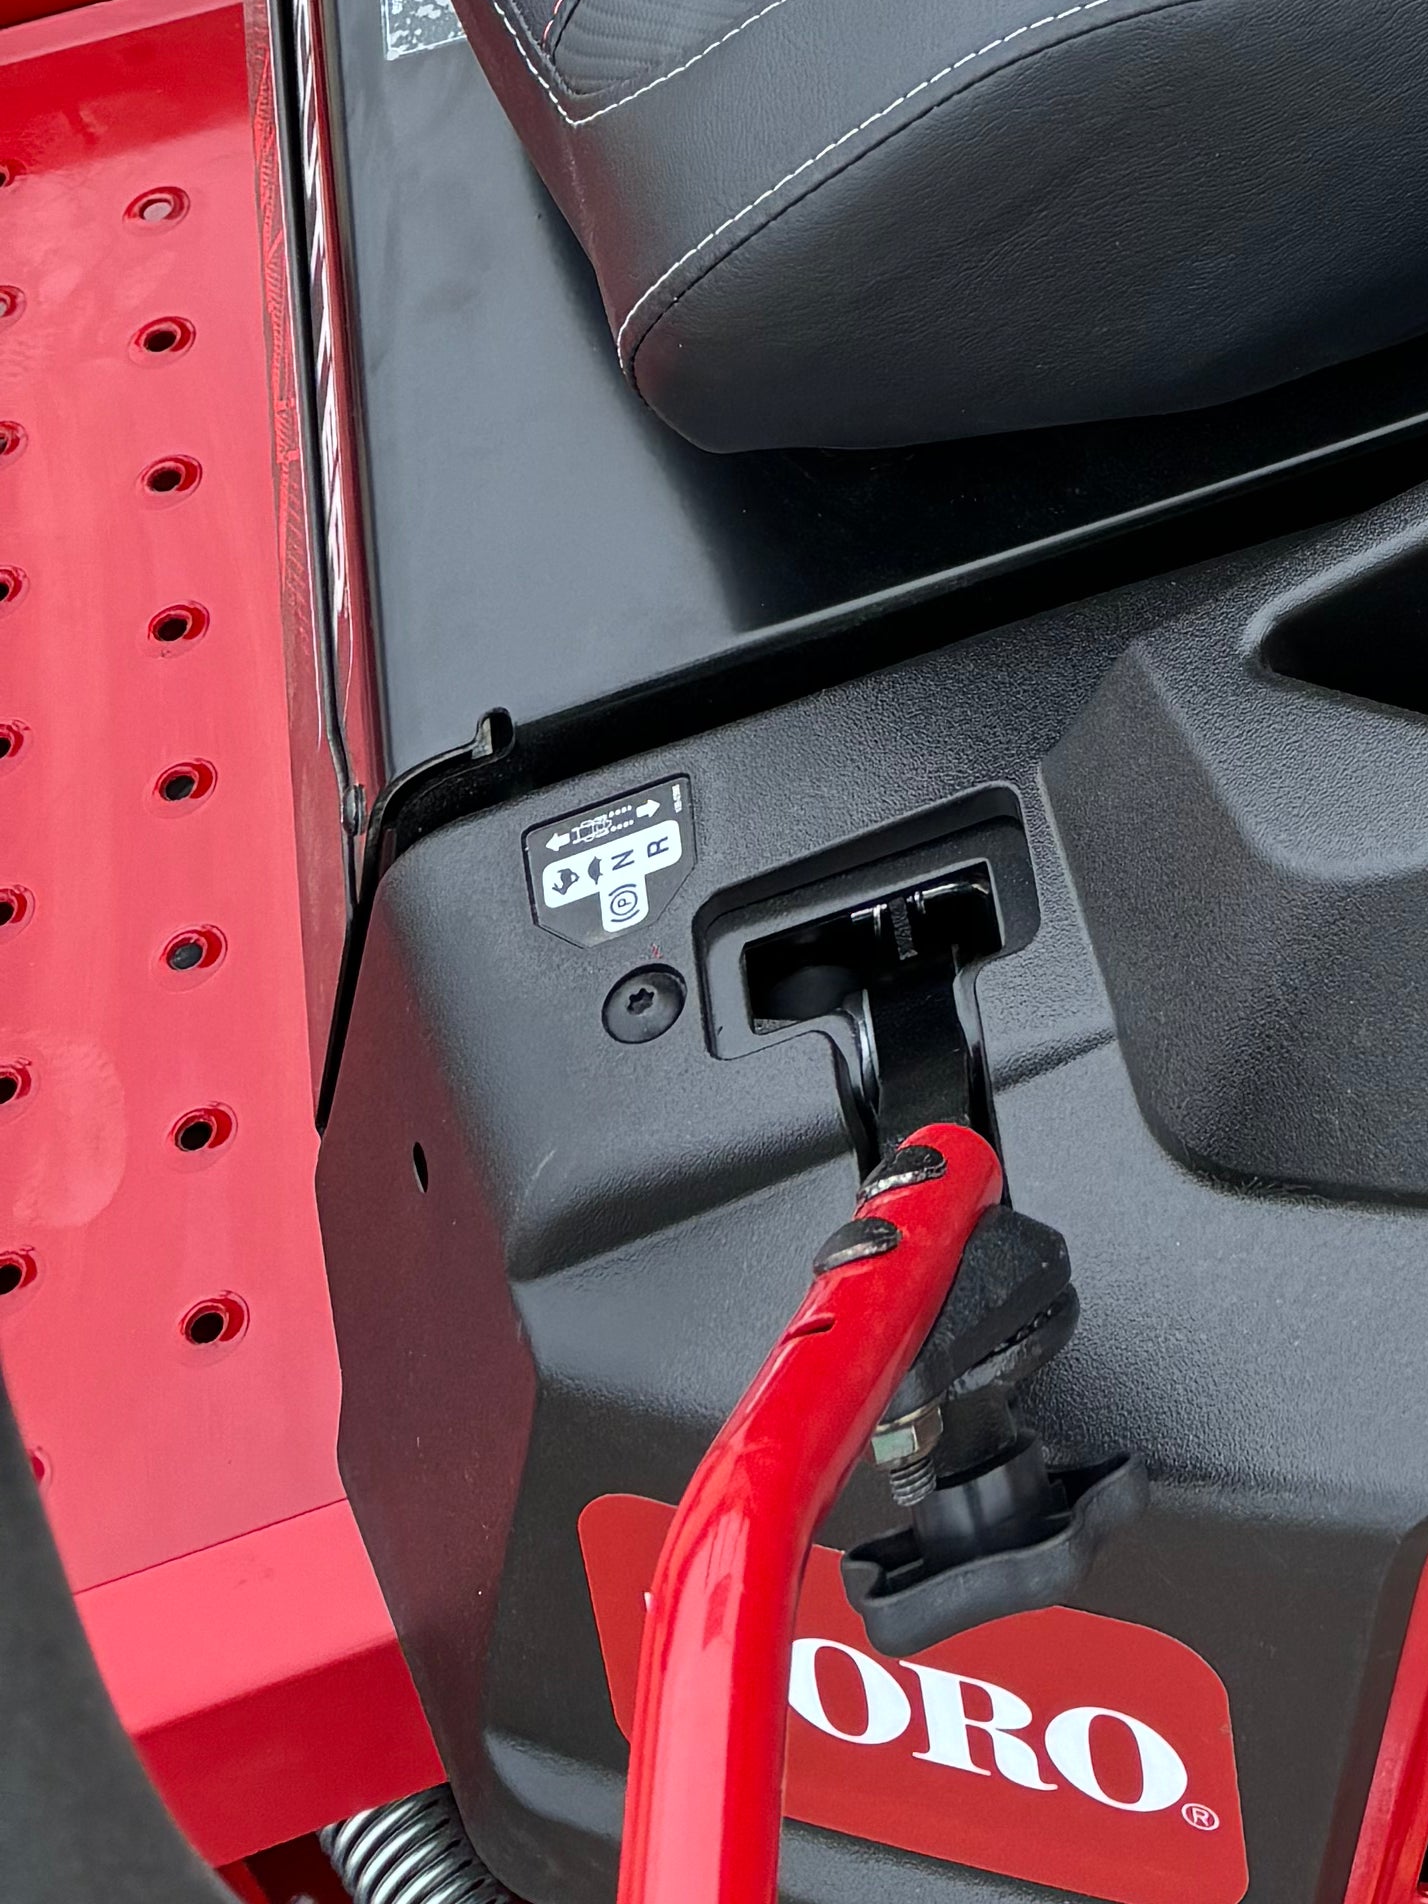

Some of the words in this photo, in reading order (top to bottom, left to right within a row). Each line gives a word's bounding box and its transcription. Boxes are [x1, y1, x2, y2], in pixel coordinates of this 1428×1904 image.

[647, 836, 669, 858] R
[611, 849, 635, 871] N
[786, 1637, 1188, 1813] ORO
